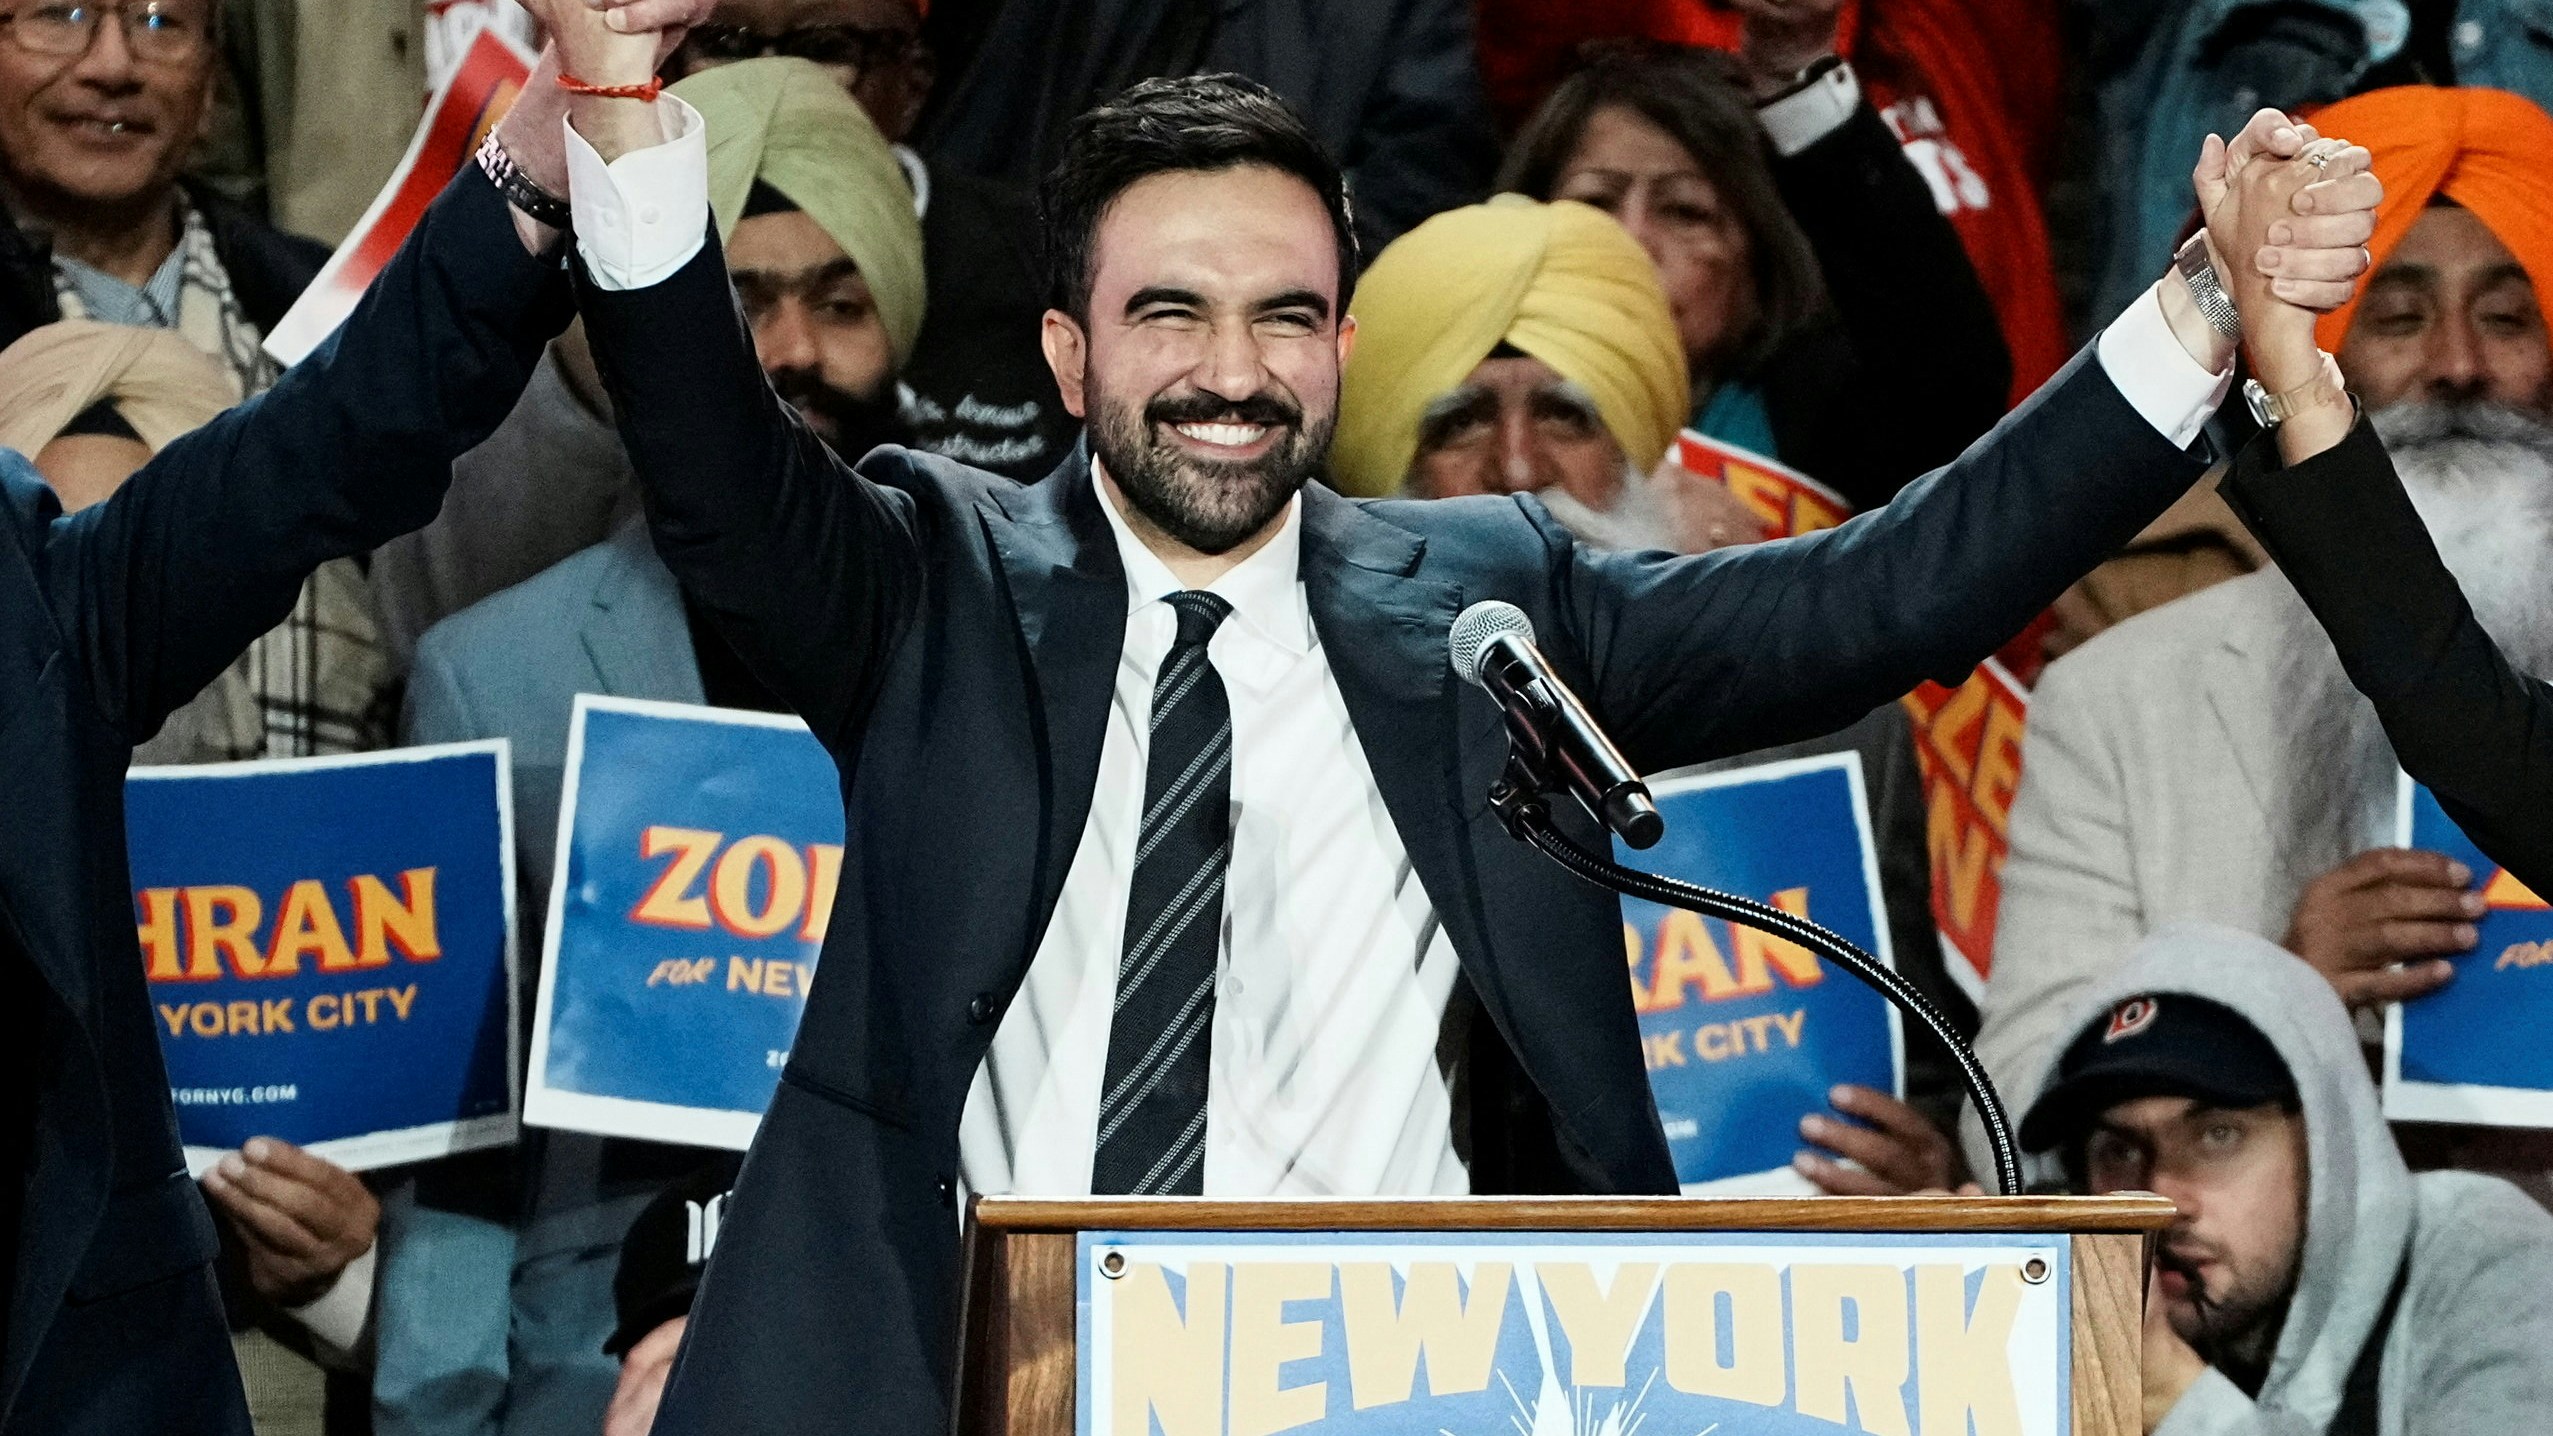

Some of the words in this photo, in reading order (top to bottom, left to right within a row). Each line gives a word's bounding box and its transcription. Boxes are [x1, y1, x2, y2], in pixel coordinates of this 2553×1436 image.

[647, 957, 716, 987] FOR
[159, 998, 295, 1038] YORK
[307, 984, 417, 1031] CITY
[1694, 1008, 1807, 1064] CITY
[1112, 1262, 1513, 1436] NEW
[1534, 1262, 2025, 1436] YORK
